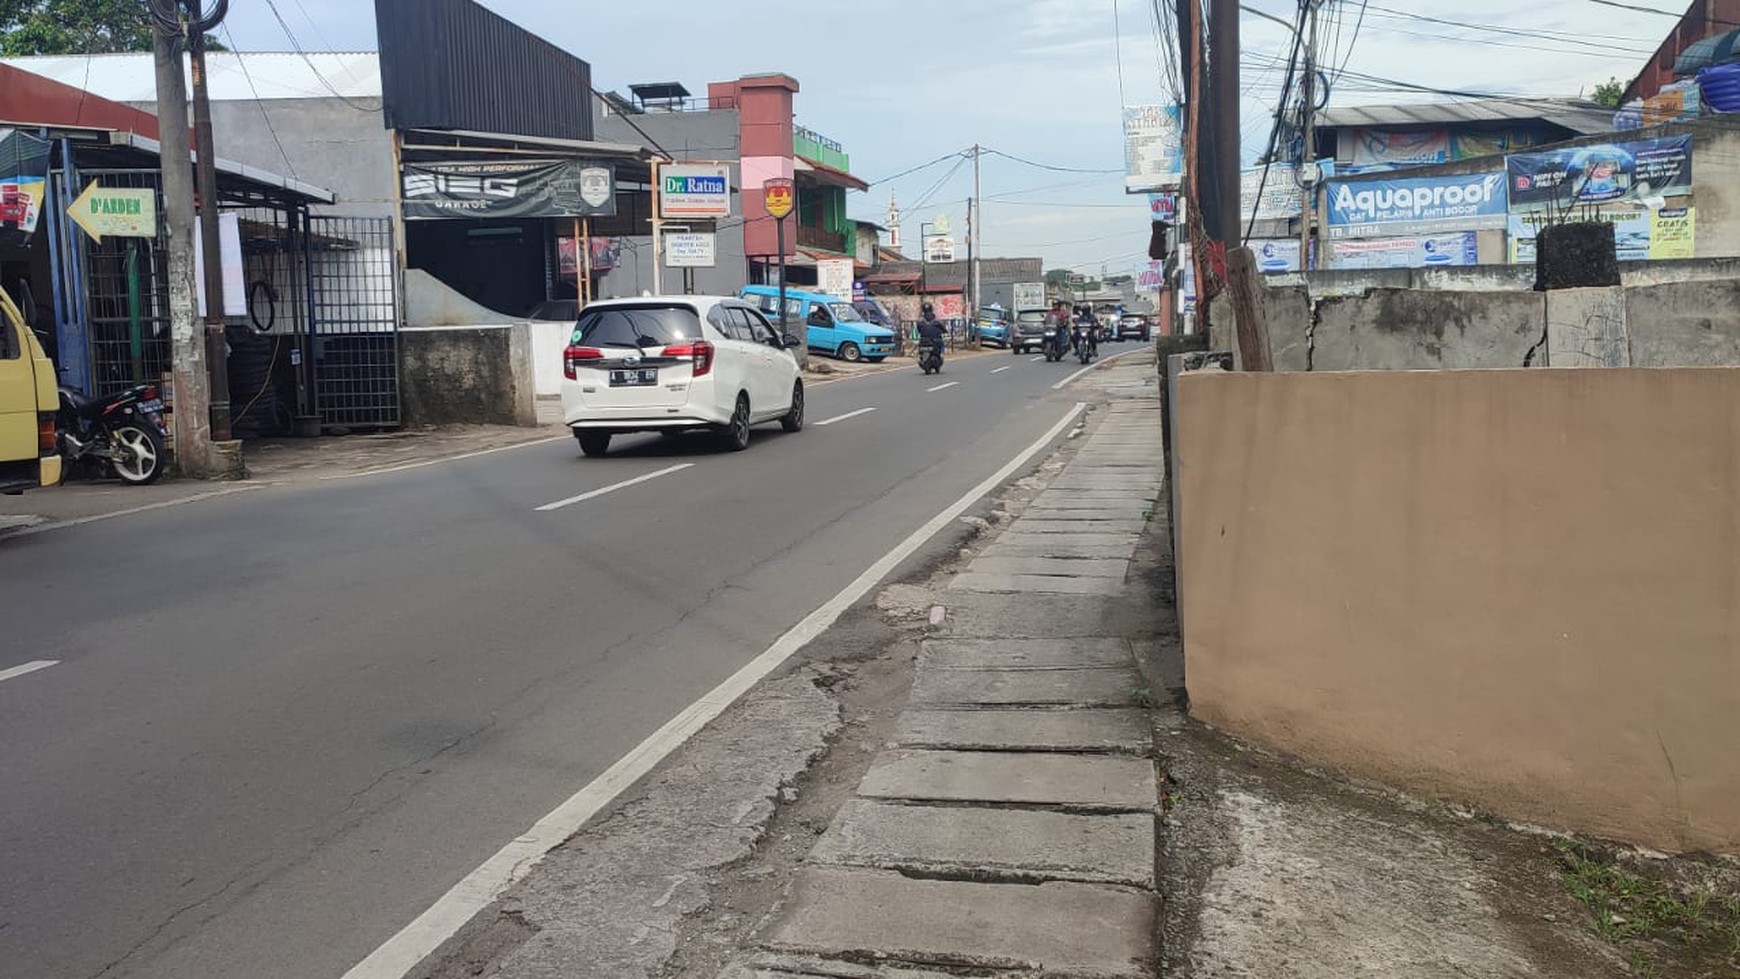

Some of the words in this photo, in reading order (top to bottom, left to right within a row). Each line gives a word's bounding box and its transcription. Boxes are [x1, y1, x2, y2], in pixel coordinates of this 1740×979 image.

[483, 164, 540, 172] PERFORMA
[666, 177, 685, 193] Dr.
[687, 177, 723, 193] Ratna
[1335, 174, 1500, 217] Aquaproof
[1349, 212, 1366, 222] CAT
[1423, 207, 1444, 218] ANTI
[1445, 205, 1478, 216] BOCOR
[1350, 225, 1380, 235] MITRA
